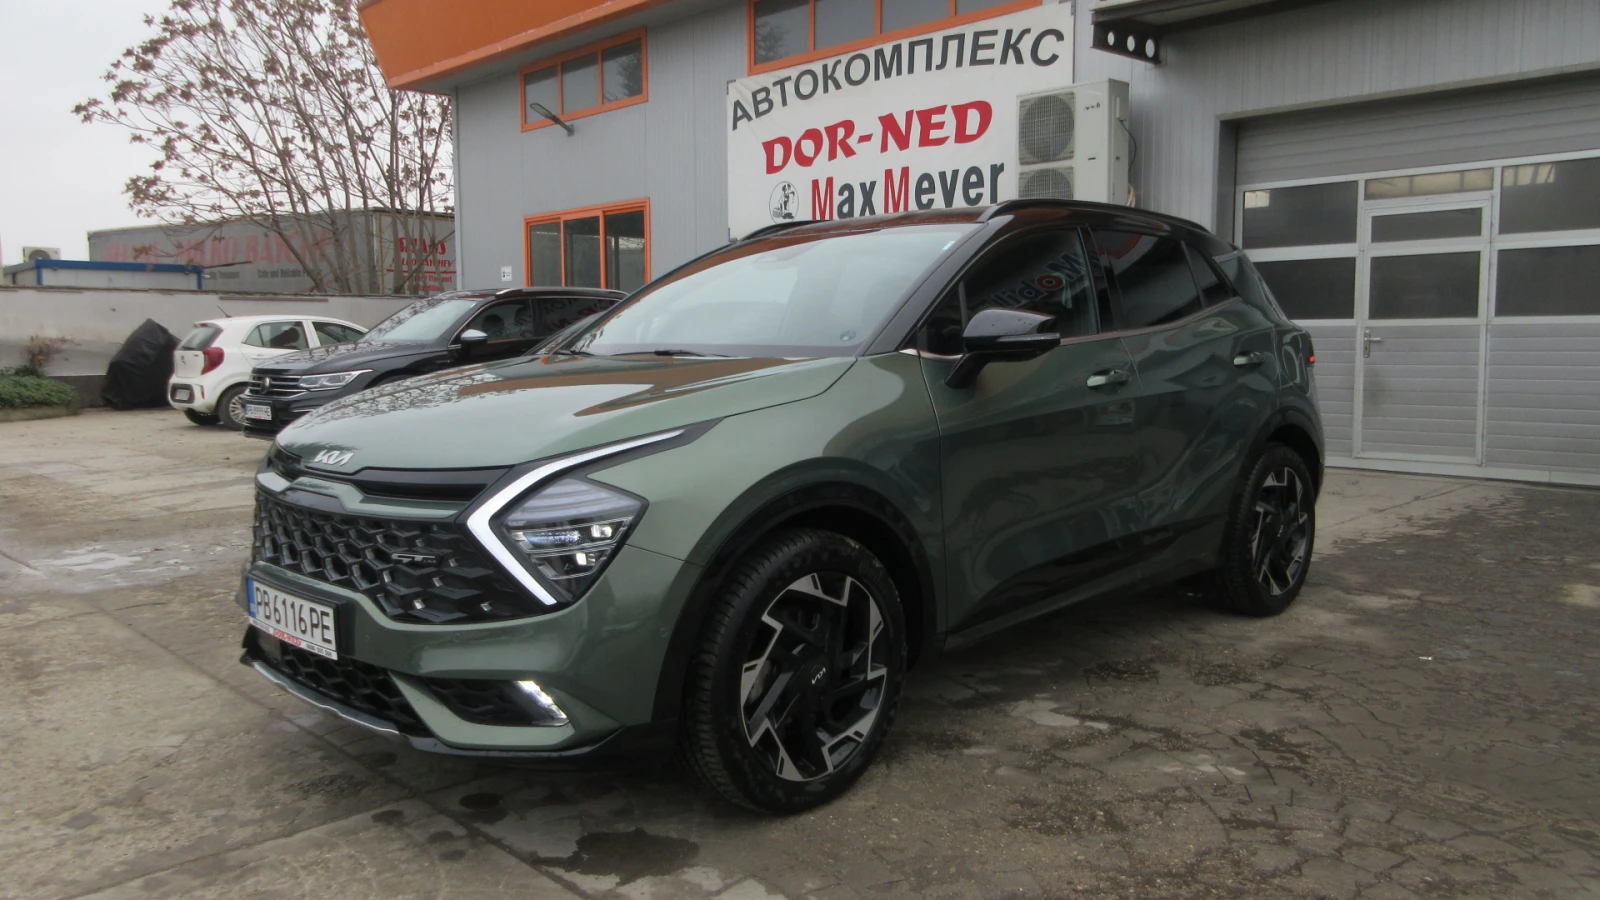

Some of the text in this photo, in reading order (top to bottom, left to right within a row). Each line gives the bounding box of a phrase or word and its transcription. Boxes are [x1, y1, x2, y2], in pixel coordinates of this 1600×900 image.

[731, 28, 1065, 131] АВТОКОМПЛЕКС
[762, 100, 993, 175] DOR-NED
[255, 586, 333, 645] PB6116PE
